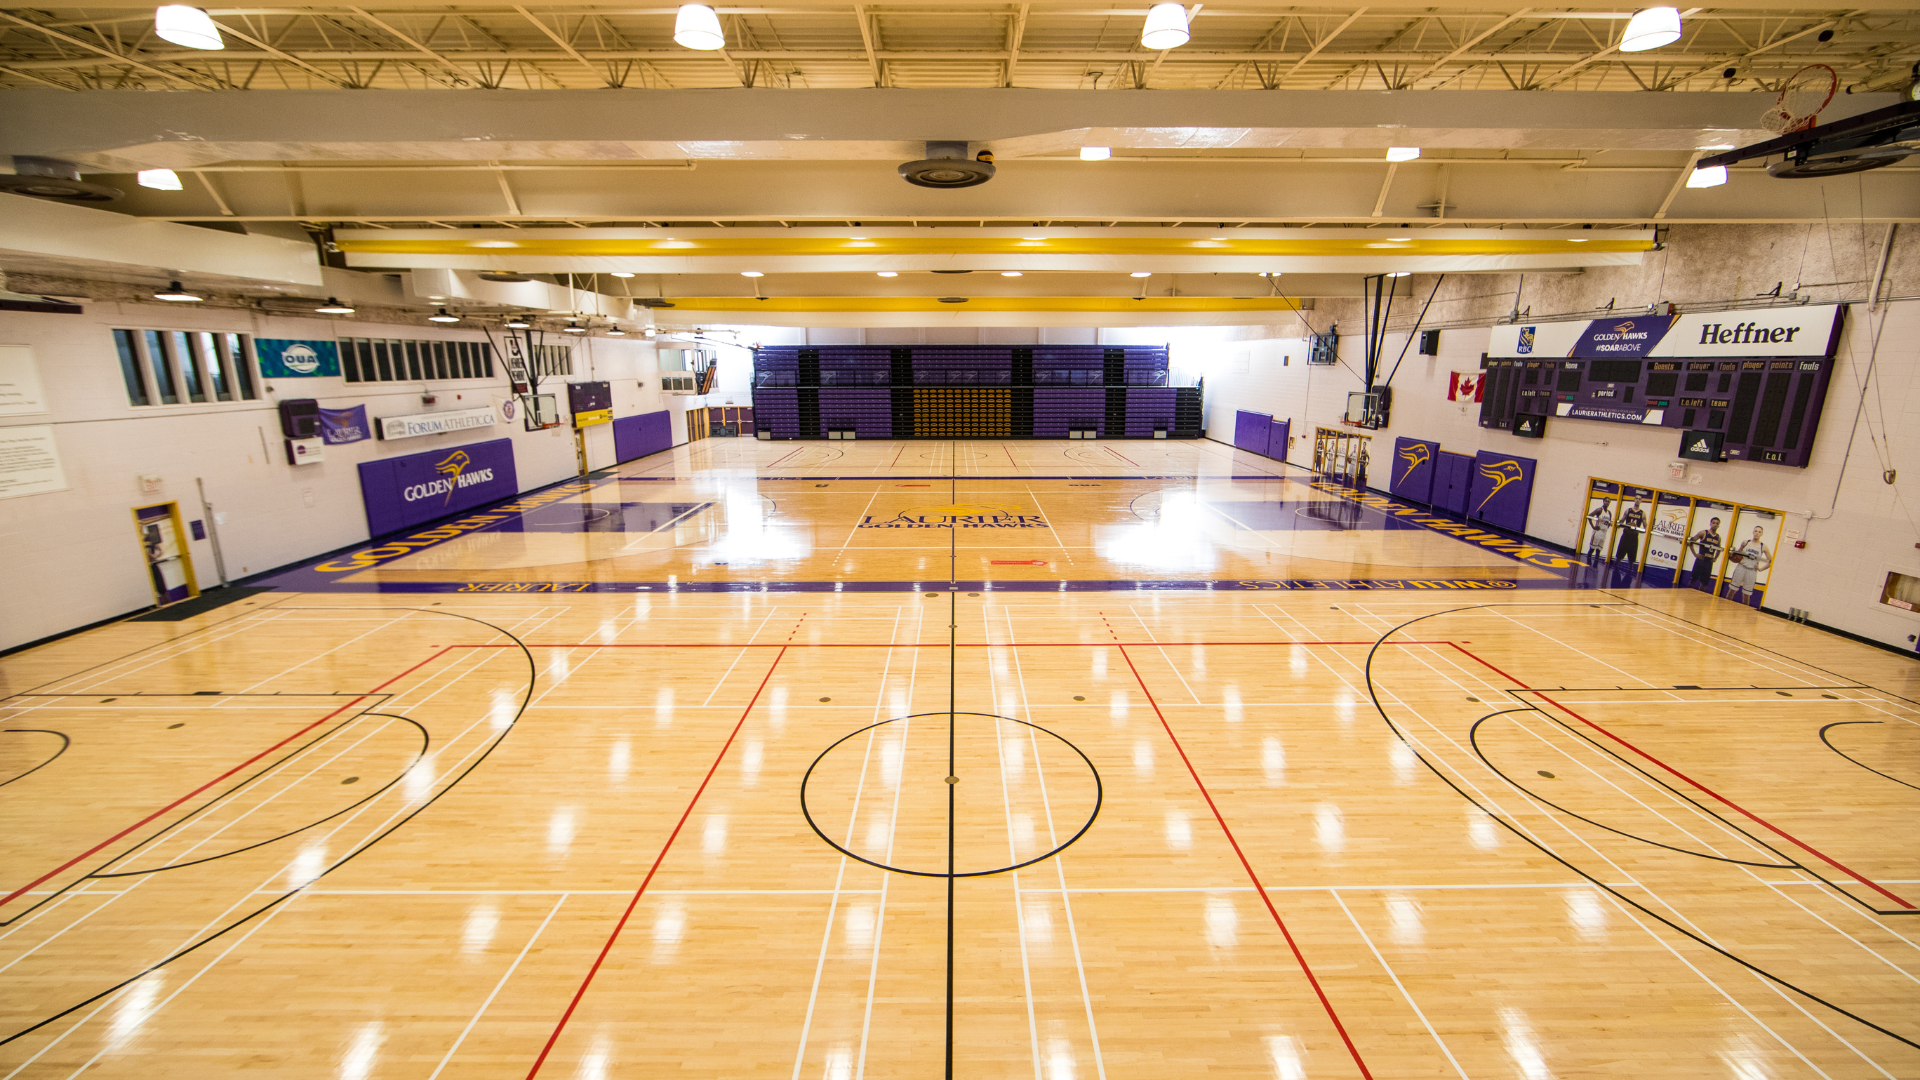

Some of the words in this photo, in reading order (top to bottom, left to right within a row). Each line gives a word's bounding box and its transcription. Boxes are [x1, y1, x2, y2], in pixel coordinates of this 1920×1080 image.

[1593, 333, 1619, 341] GOLDEN
[1622, 332, 1648, 340] HAWKS
[1699, 321, 1800, 345] Heffner
[1518, 345, 1532, 353] RBC
[1595, 343, 1641, 352] #SOARABOVE
[285, 355, 316, 363] OUA
[1653, 362, 1674, 370] Guests
[1689, 362, 1711, 371] player
[1719, 363, 1736, 371] fouls
[1742, 361, 1764, 370] player
[1770, 362, 1793, 370] points
[1799, 361, 1820, 371] fouls
[1597, 390, 1614, 398] period
[1571, 409, 1643, 421] LAURIERATHLETICS.COM
[404, 478, 453, 502] GOLDEN
[457, 468, 494, 488] HAWKS
[859, 515, 1044, 524] LAURIER
[314, 514, 509, 572] GOLDEN
[1411, 518, 1590, 568] HAWKS
[457, 582, 590, 592] LAURIER
